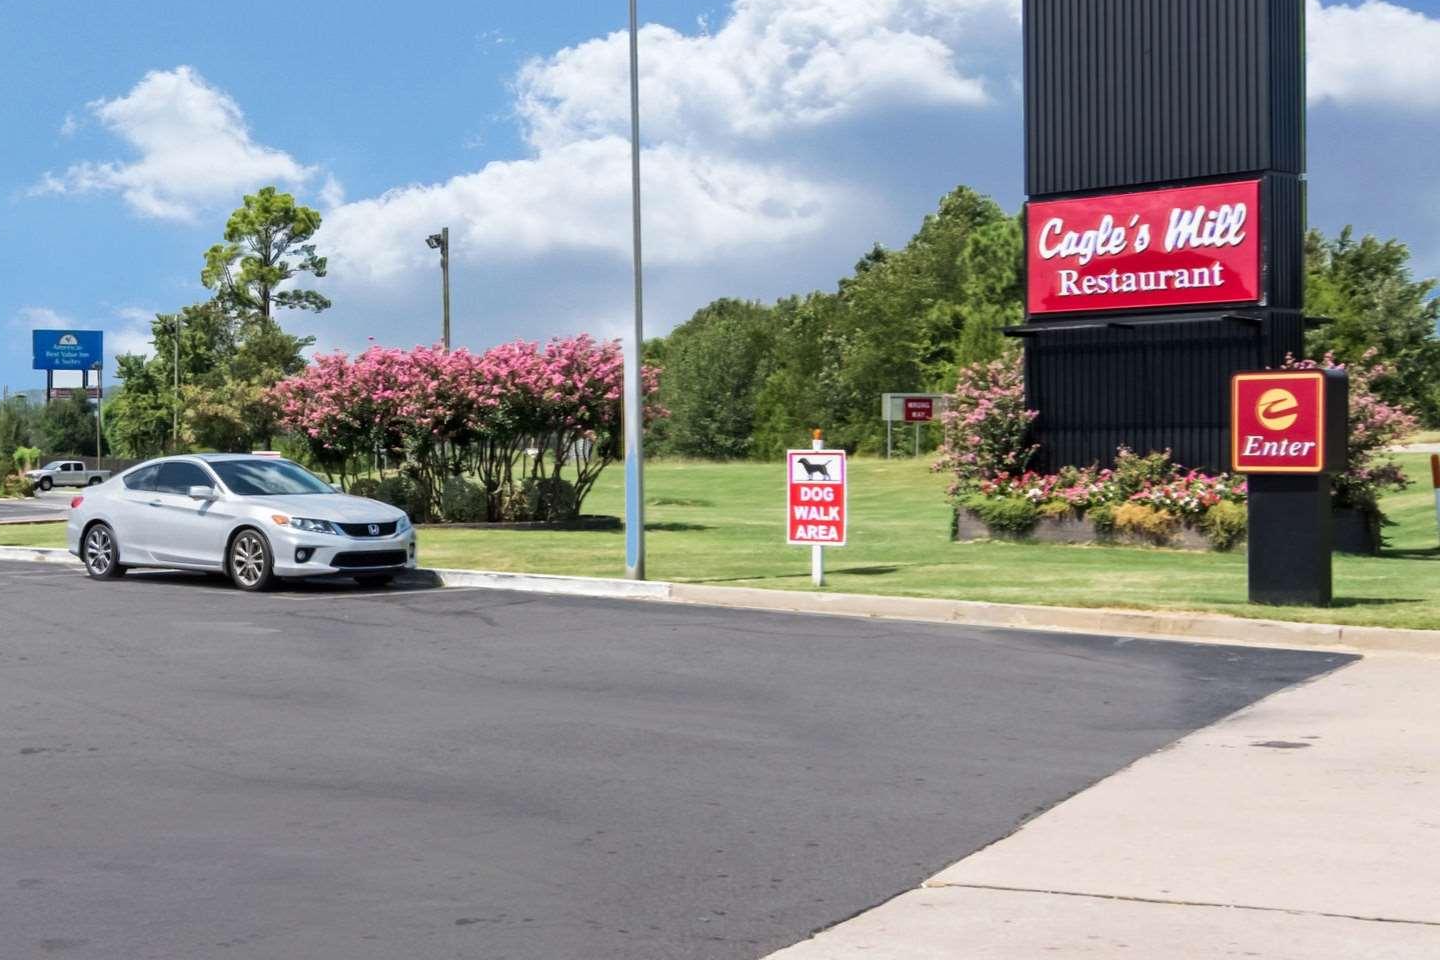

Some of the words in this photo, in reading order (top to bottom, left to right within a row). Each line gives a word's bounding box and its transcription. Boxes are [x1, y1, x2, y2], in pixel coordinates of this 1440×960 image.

[1038, 213, 1152, 266] Cagle's
[1163, 202, 1248, 253] Mill
[1057, 260, 1226, 297] Restaurant
[1241, 434, 1317, 457] Enter
[799, 486, 835, 502] DOG
[793, 505, 841, 521] WALK
[795, 524, 839, 540] AREA
